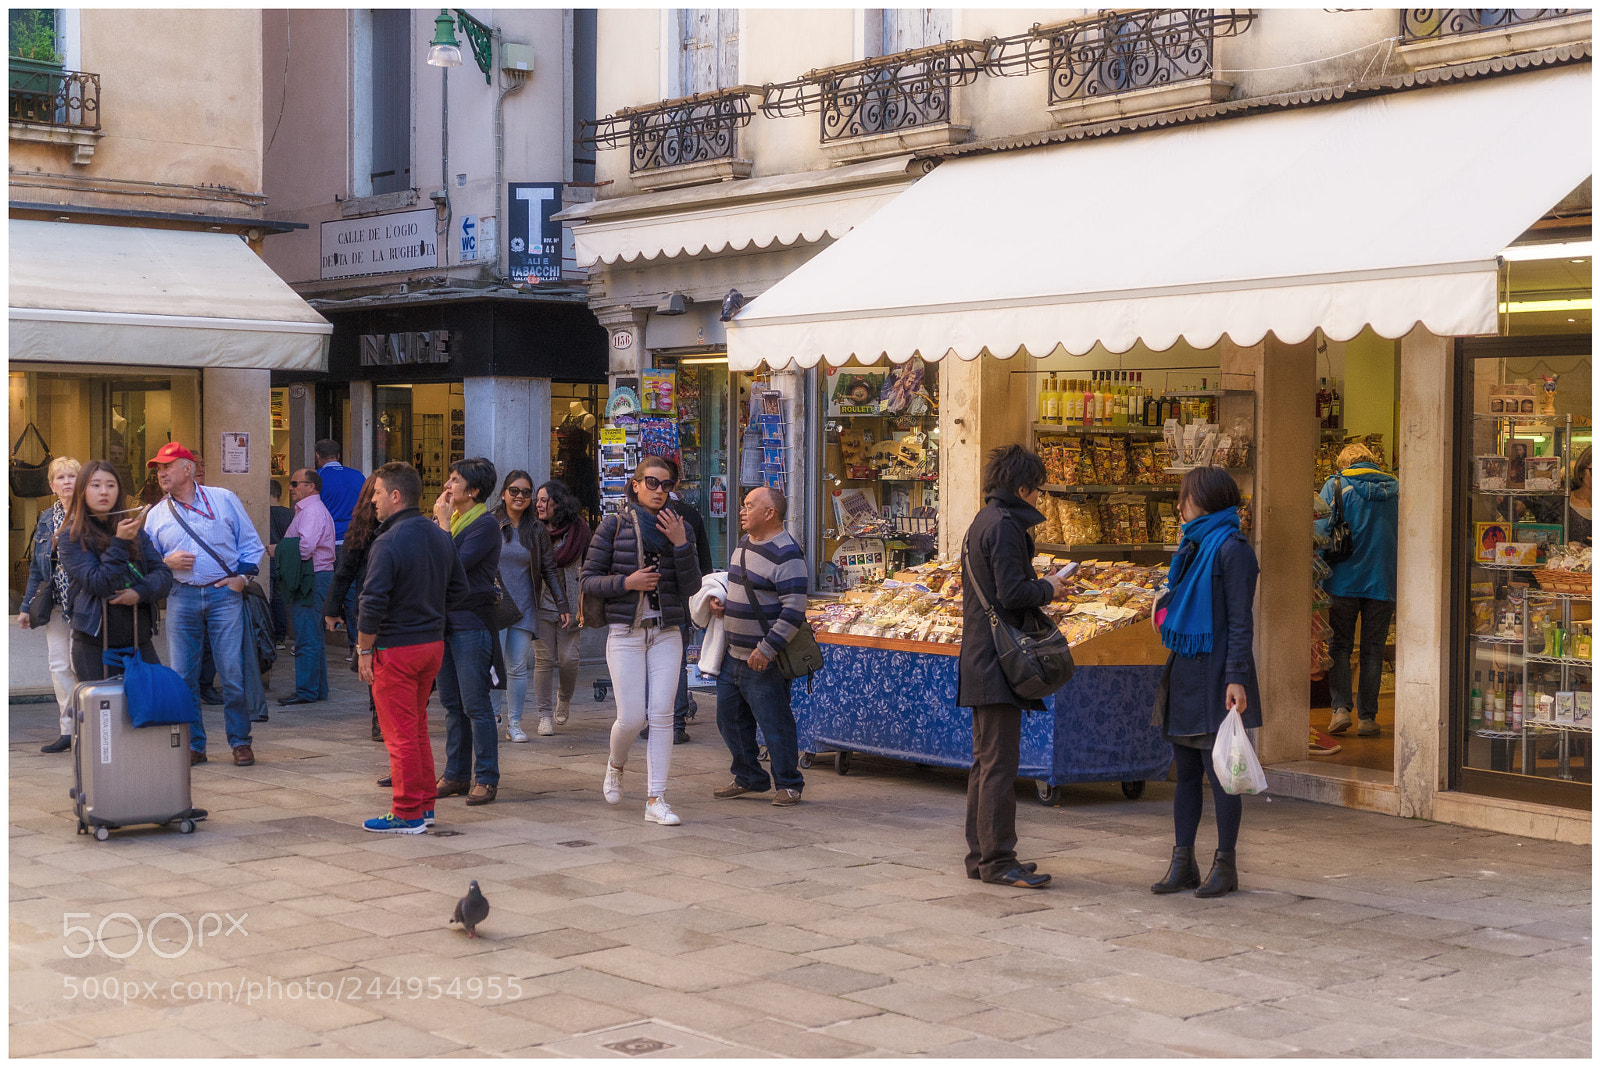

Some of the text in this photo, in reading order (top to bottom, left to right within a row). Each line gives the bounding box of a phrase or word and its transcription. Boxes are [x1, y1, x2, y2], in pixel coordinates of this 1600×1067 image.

[338, 229, 365, 245] CALLE
[368, 227, 380, 241] DE
[461, 236, 475, 251] WC
[322, 240, 436, 268] DETA DE LA RUGHETA
[510, 265, 560, 277] TABACCHI
